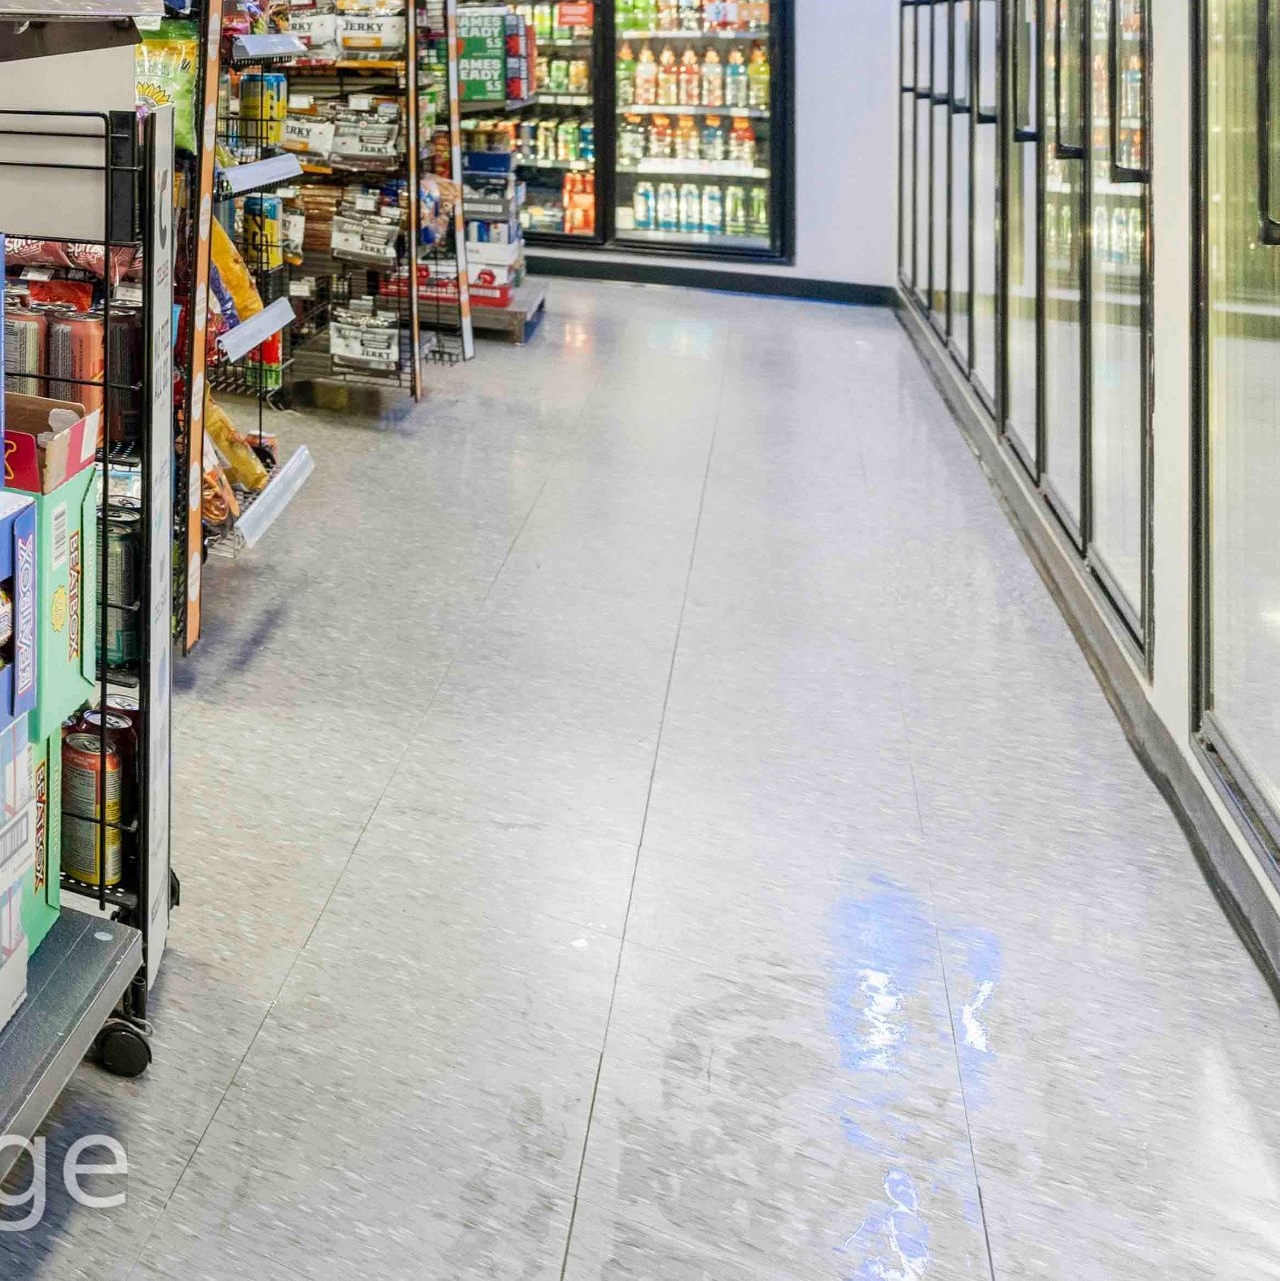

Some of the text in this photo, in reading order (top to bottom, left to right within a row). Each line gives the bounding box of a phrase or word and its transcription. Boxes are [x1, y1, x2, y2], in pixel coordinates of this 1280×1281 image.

[343, 22, 384, 31] JERKY
[459, 16, 501, 27] AMES
[459, 27, 500, 37] EADY
[459, 58, 501, 69] AMES
[459, 70, 500, 80] EADY
[69, 533, 80, 661] BEATBOX
[18, 539, 33, 693] BEATBOX
[35, 761, 46, 892] BEATBOX
